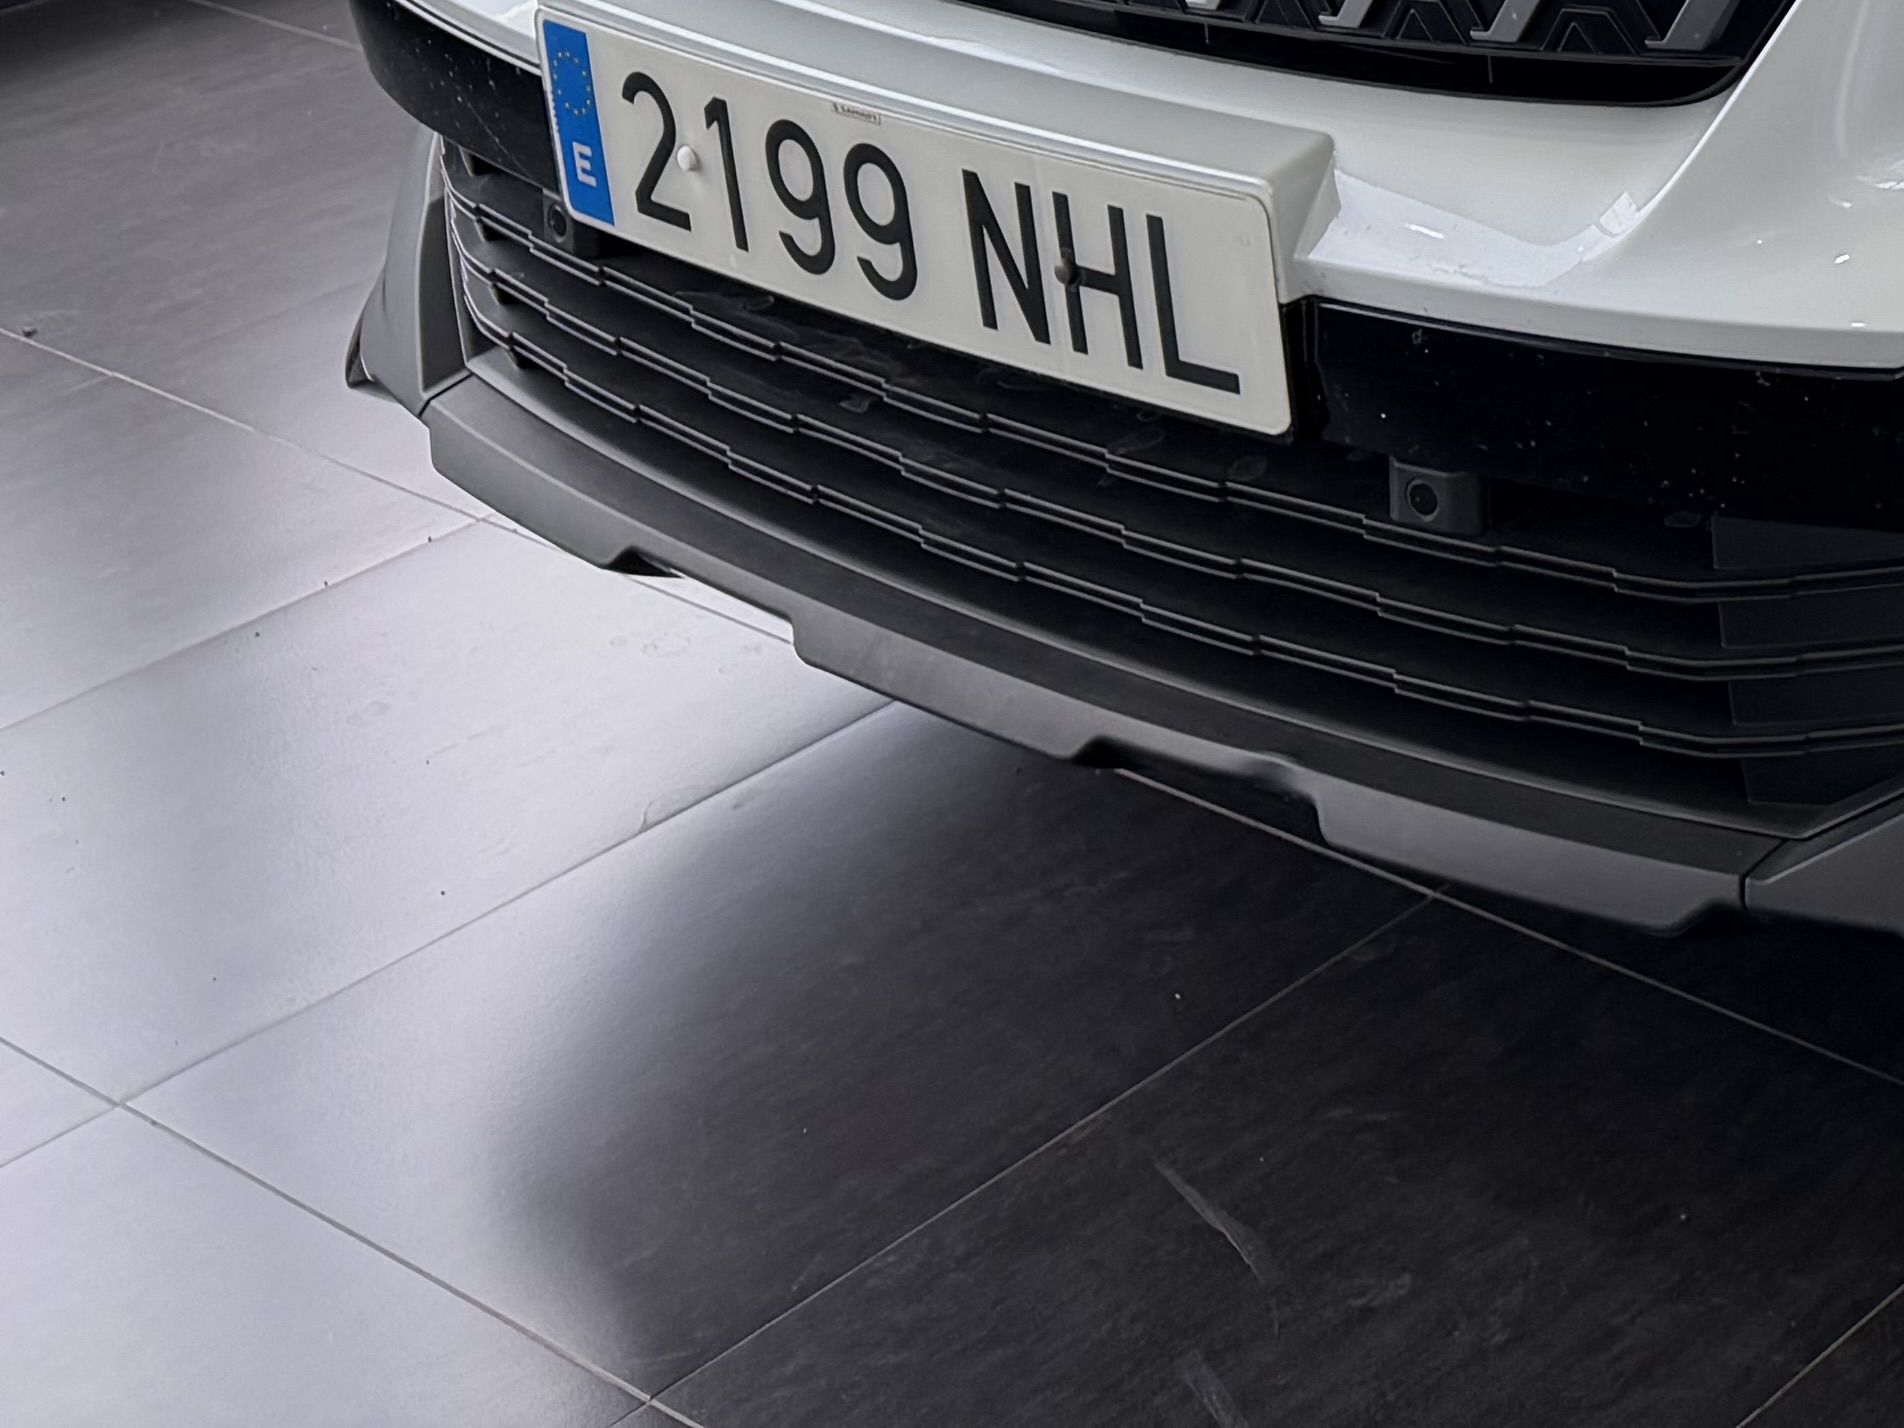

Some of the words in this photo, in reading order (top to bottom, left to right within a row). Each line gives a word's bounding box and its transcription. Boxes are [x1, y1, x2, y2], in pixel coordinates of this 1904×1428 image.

[571, 140, 598, 188] E
[620, 71, 919, 302] 2199
[960, 168, 1242, 396] NHL
